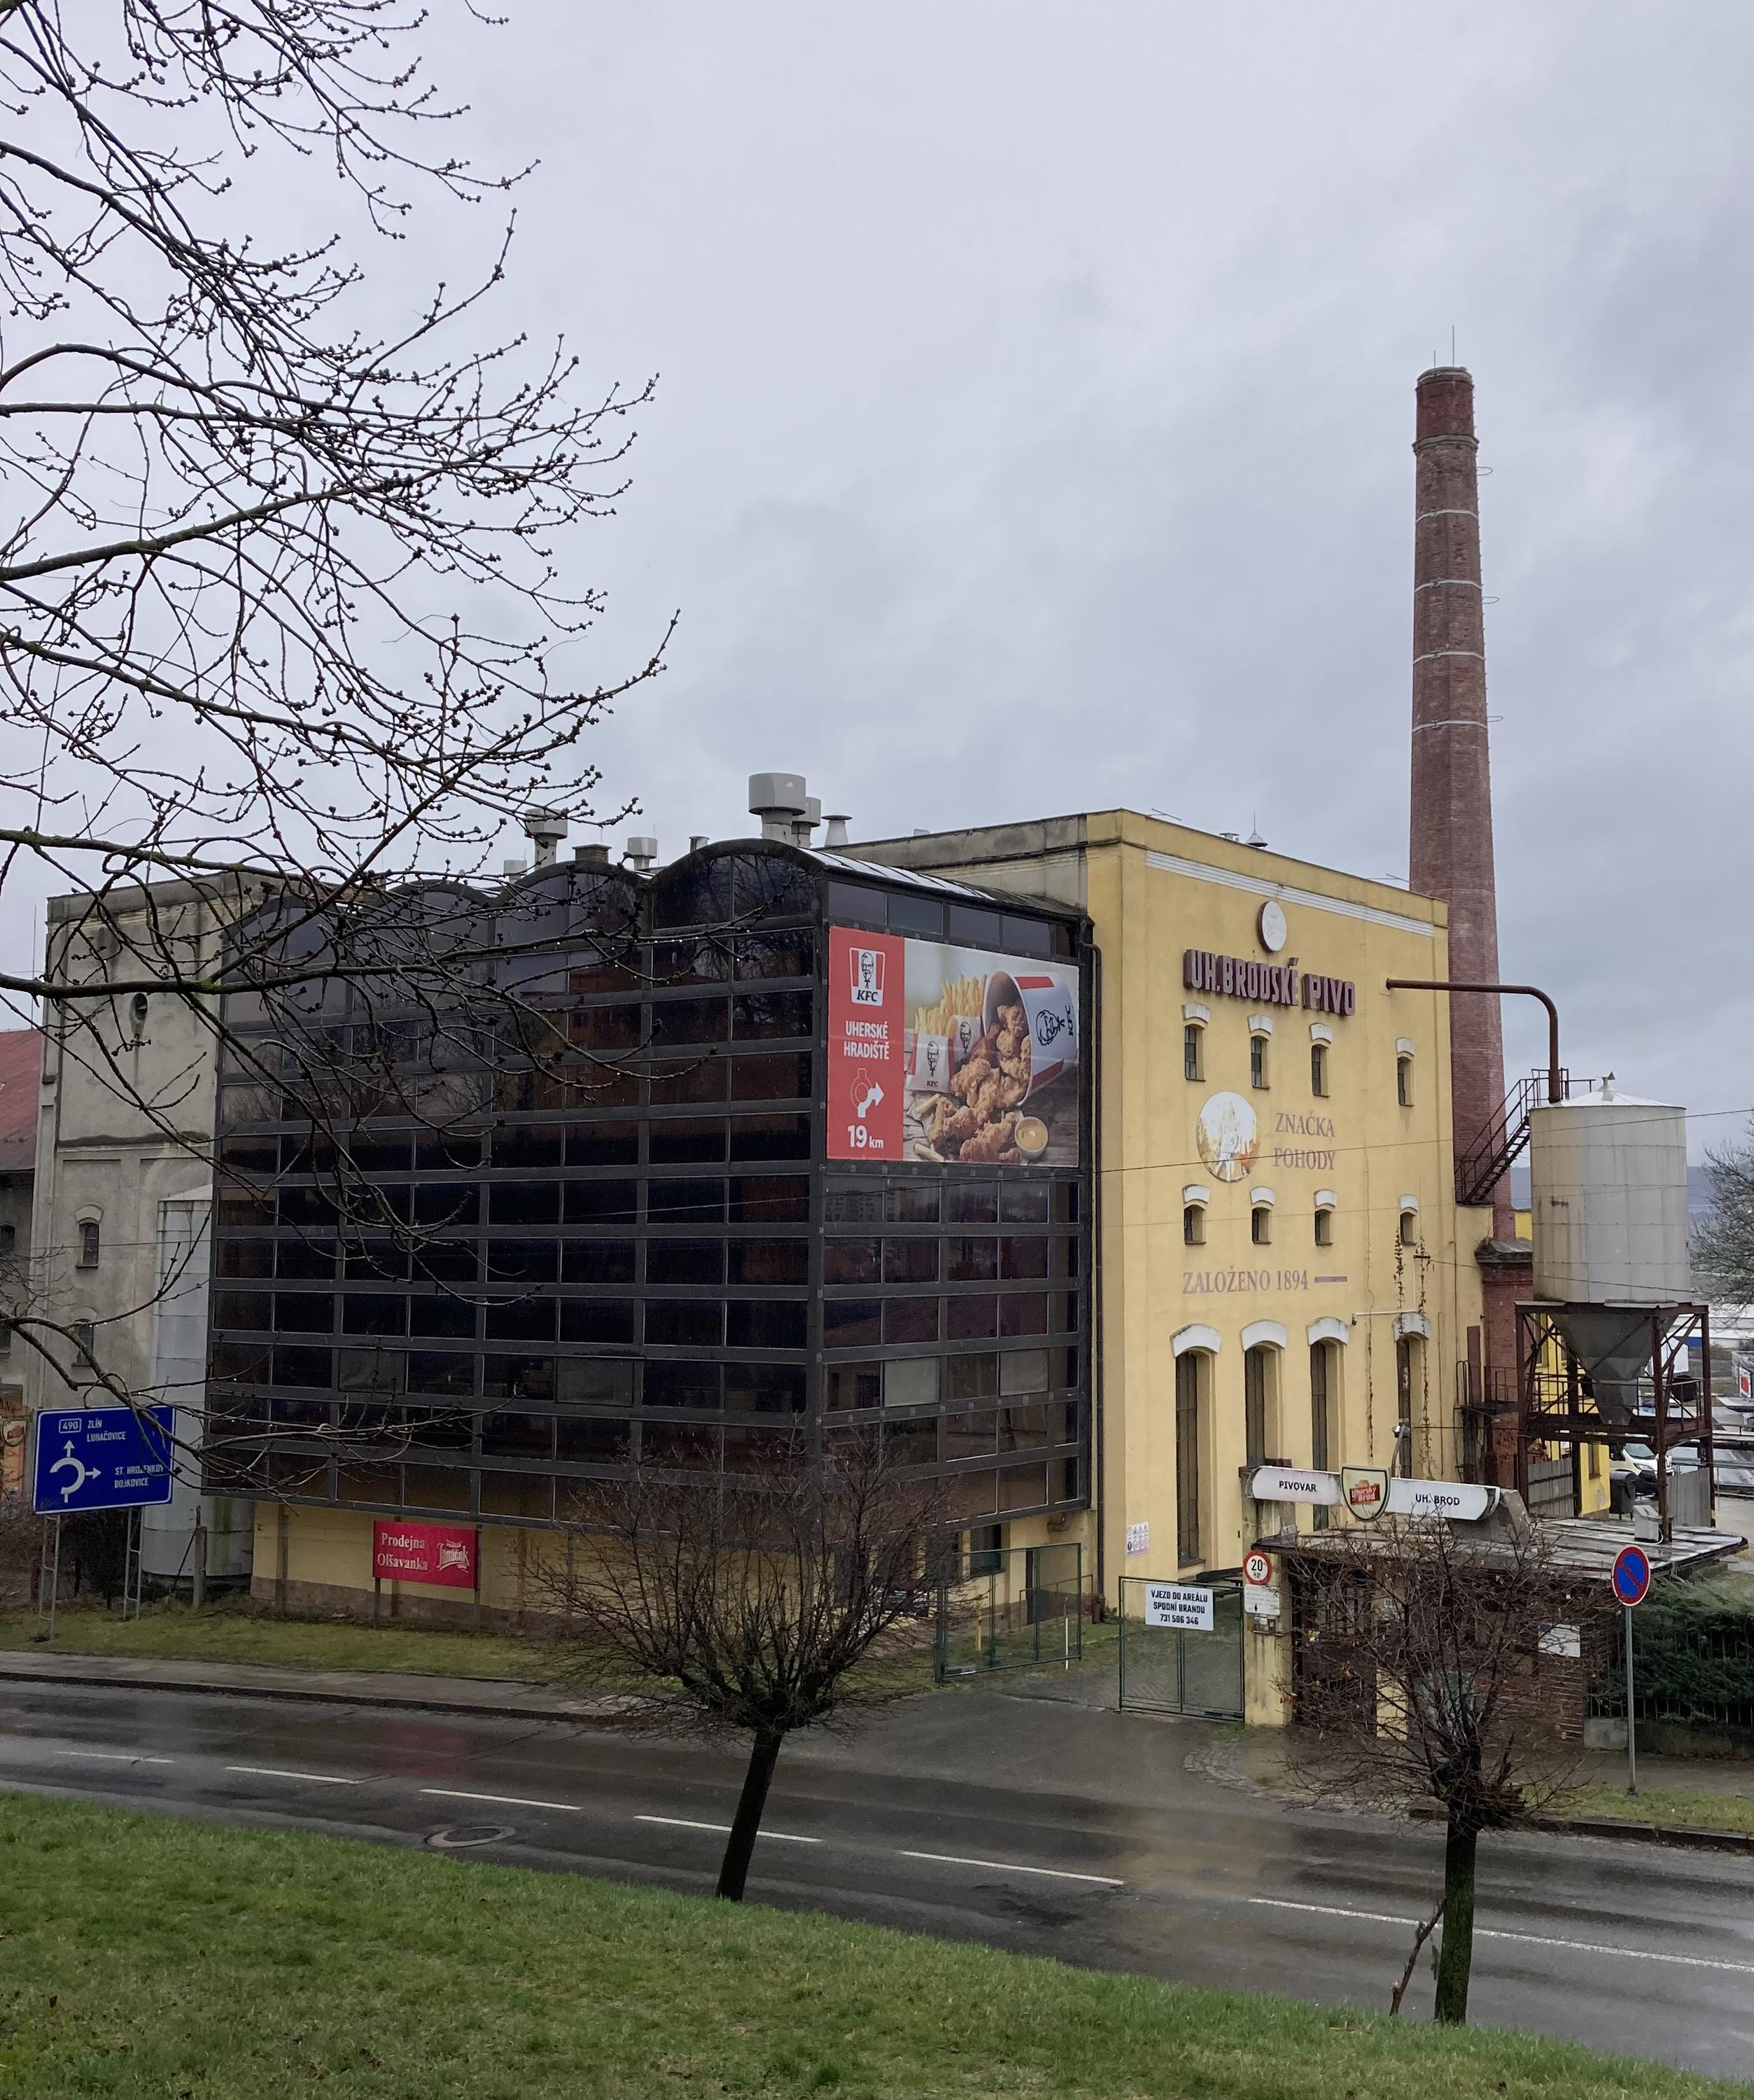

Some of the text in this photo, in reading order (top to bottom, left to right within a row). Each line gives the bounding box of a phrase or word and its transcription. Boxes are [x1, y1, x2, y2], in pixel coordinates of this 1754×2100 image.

[857, 990, 878, 1002] KFC
[1303, 974, 1355, 1016] PIVO
[1063, 1005, 1074, 1037] KFC
[846, 1020, 889, 1040] UHERSKÉ
[843, 1039, 890, 1060] HRADIŠTĚ
[1275, 1110, 1335, 1138] ZNAČKA
[848, 1125, 884, 1149] 19 km
[1274, 1146, 1336, 1170] POHODY
[1183, 1265, 1308, 1294] ZALOŽENO 1894
[62, 1418, 102, 1430] 490 ZLÍN
[114, 1478, 149, 1489] BOJKOVICE
[1279, 1480, 1317, 1492] PIVOVAR
[1358, 1494, 1375, 1502] Brod
[1415, 1493, 1460, 1506] UH. BROD
[381, 1532, 426, 1552] Prodejna
[377, 1553, 429, 1571] Olšavanka
[1251, 1558, 1263, 1572] 20
[1151, 1590, 1208, 1603] VJEZD DO AREÁLU
[1153, 1601, 1205, 1614] SPODNÍ BRANOU
[1160, 1614, 1199, 1625] 731 506 346
